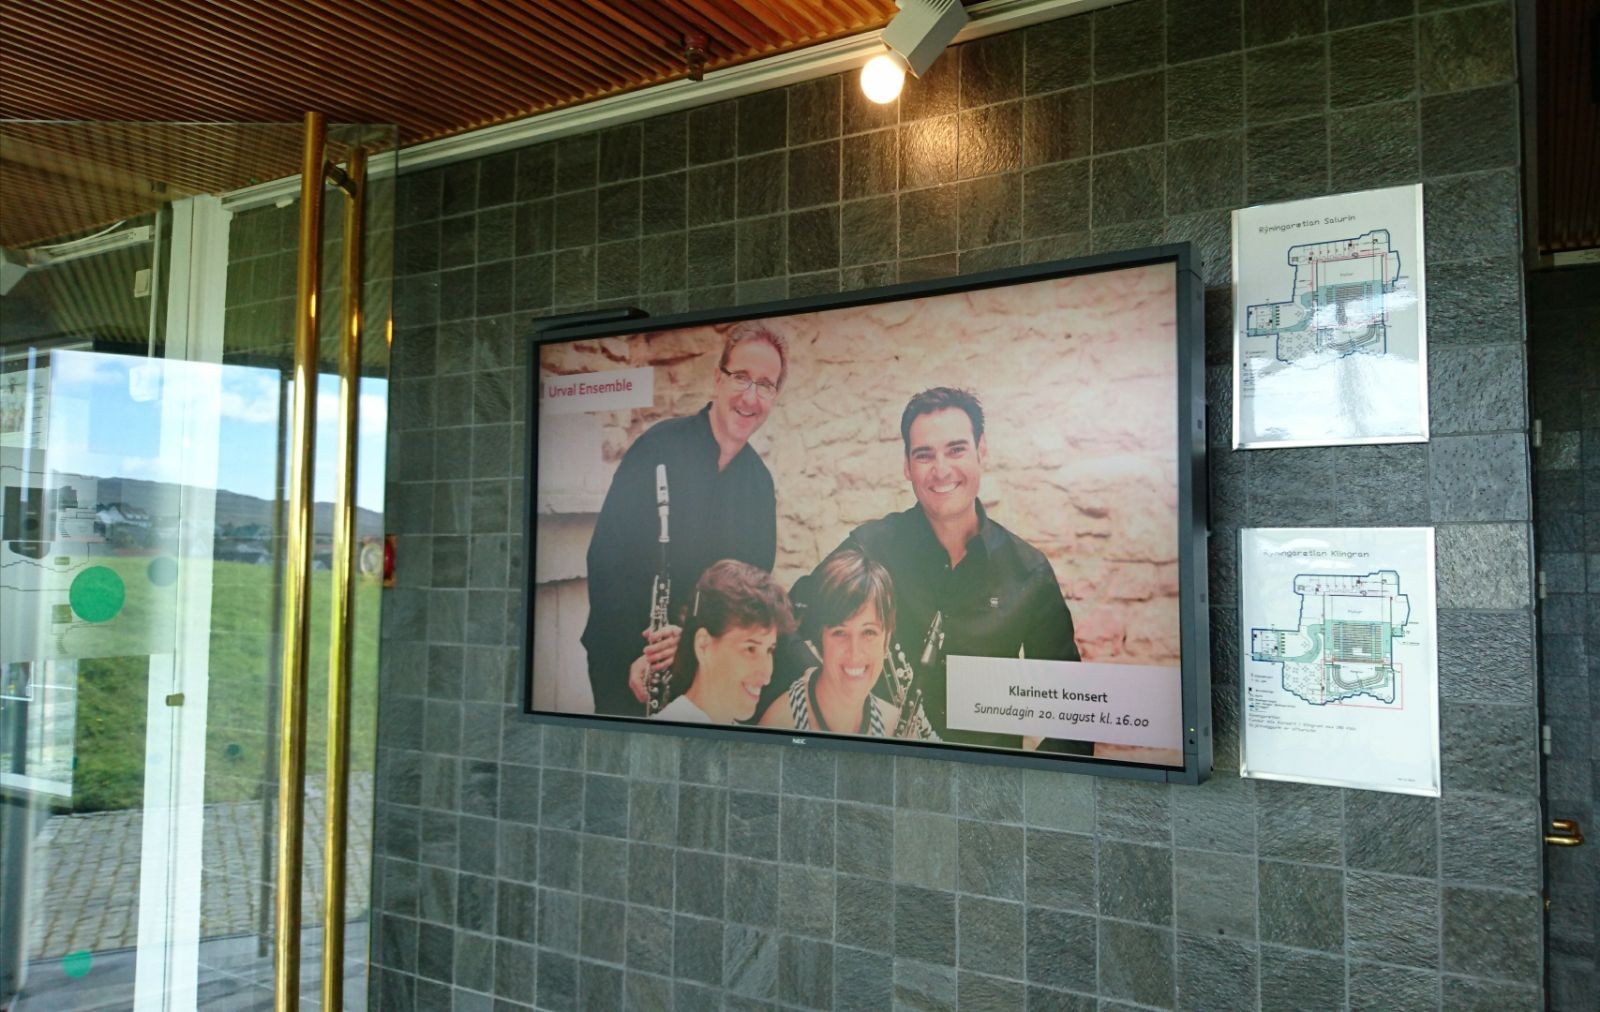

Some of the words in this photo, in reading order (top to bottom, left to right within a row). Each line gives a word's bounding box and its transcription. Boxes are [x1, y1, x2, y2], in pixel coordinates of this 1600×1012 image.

[548, 384, 576, 398] Urval
[579, 379, 633, 395] Ensemble
[1008, 685, 1058, 700] Klarinett
[1062, 688, 1108, 704] konsert
[974, 703, 1034, 720] Sunnudagin
[1038, 710, 1055, 720] 20.
[1058, 711, 1096, 725] august
[1099, 712, 1113, 725] kl.
[1115, 714, 1150, 728] 16.00
